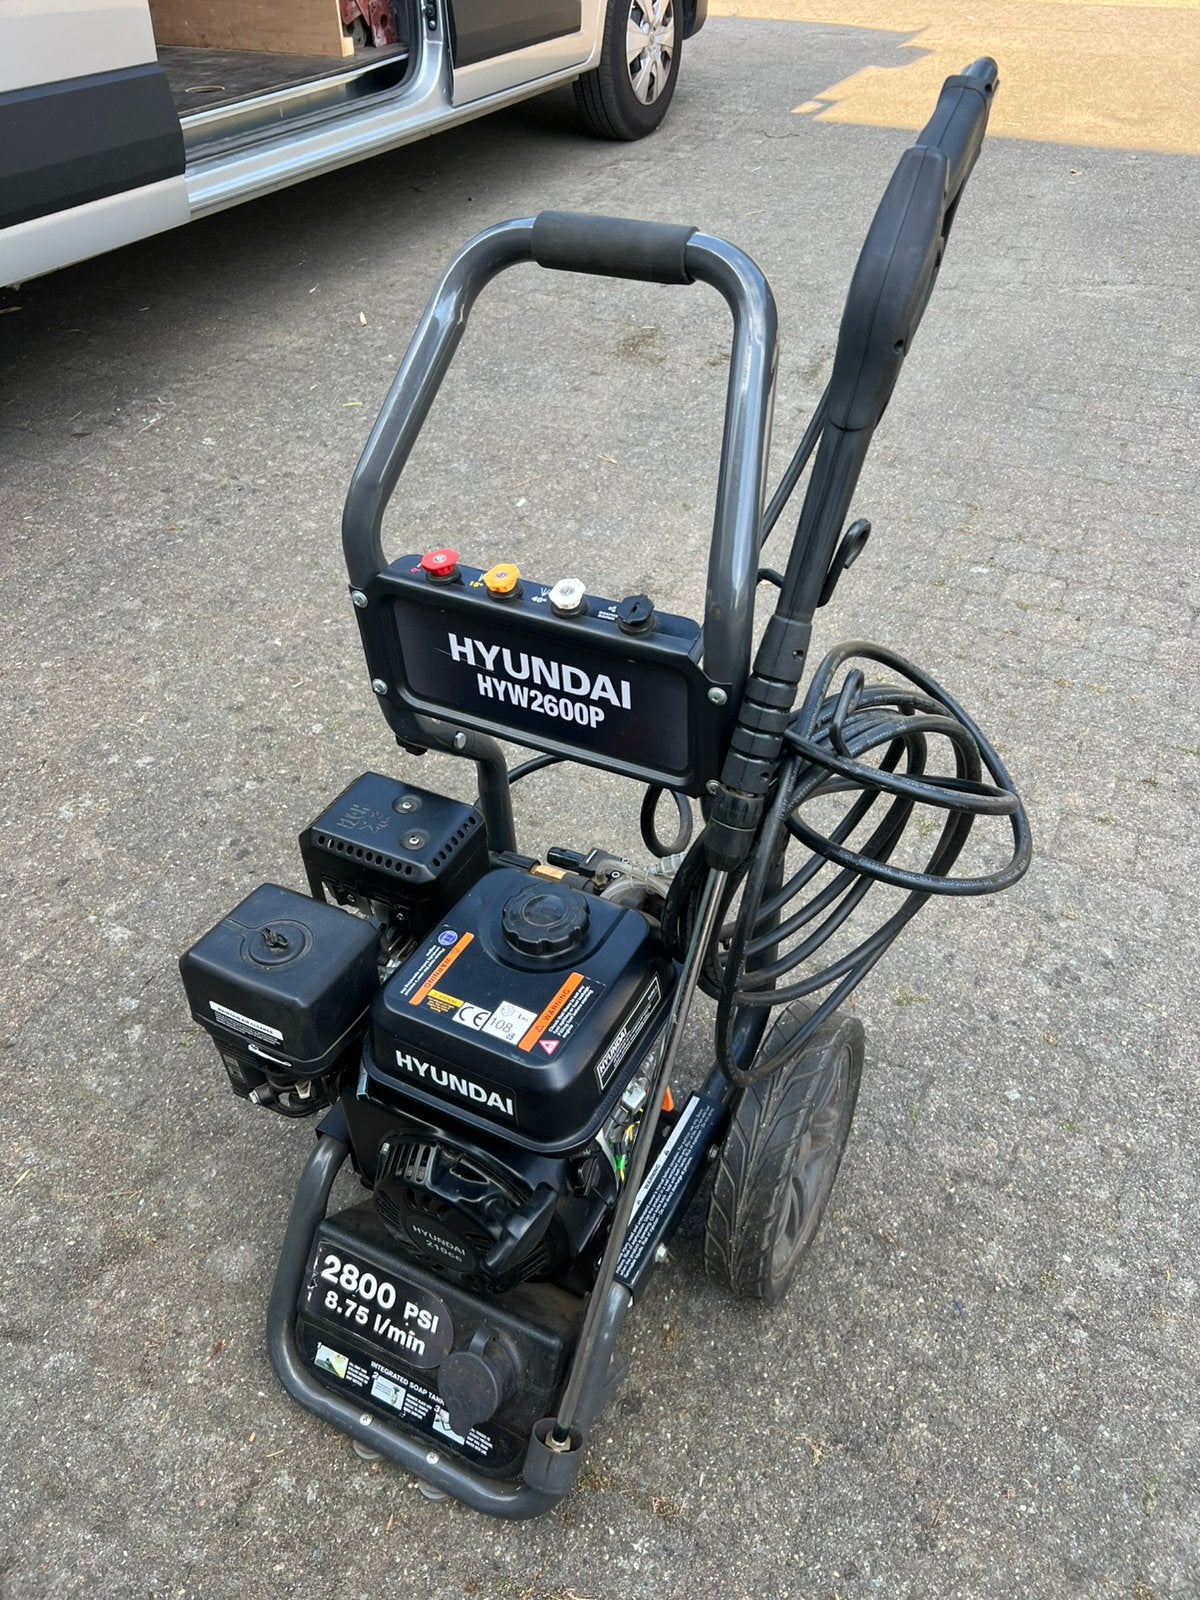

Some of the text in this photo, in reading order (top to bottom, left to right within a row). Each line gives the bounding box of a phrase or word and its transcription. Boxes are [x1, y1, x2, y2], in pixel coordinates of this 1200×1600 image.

[448, 632, 631, 710] HYUNDAI
[477, 674, 604, 728] HYW2600P
[543, 988, 570, 1022] WARNING
[490, 1017, 513, 1033] 108
[600, 1028, 626, 1074] HYUNDAI
[396, 1050, 514, 1116] HYUNDAI
[644, 1164, 660, 1190] WARNING
[413, 1225, 466, 1255] HYUNDAI
[321, 1255, 438, 1334] 2800 PSI
[324, 1290, 426, 1356] 8.75 l/min
[370, 1360, 408, 1386] INTEGRATED
[409, 1382, 428, 1395] SOAP
[373, 1372, 379, 1380] 2
[433, 1404, 441, 1413] 3
